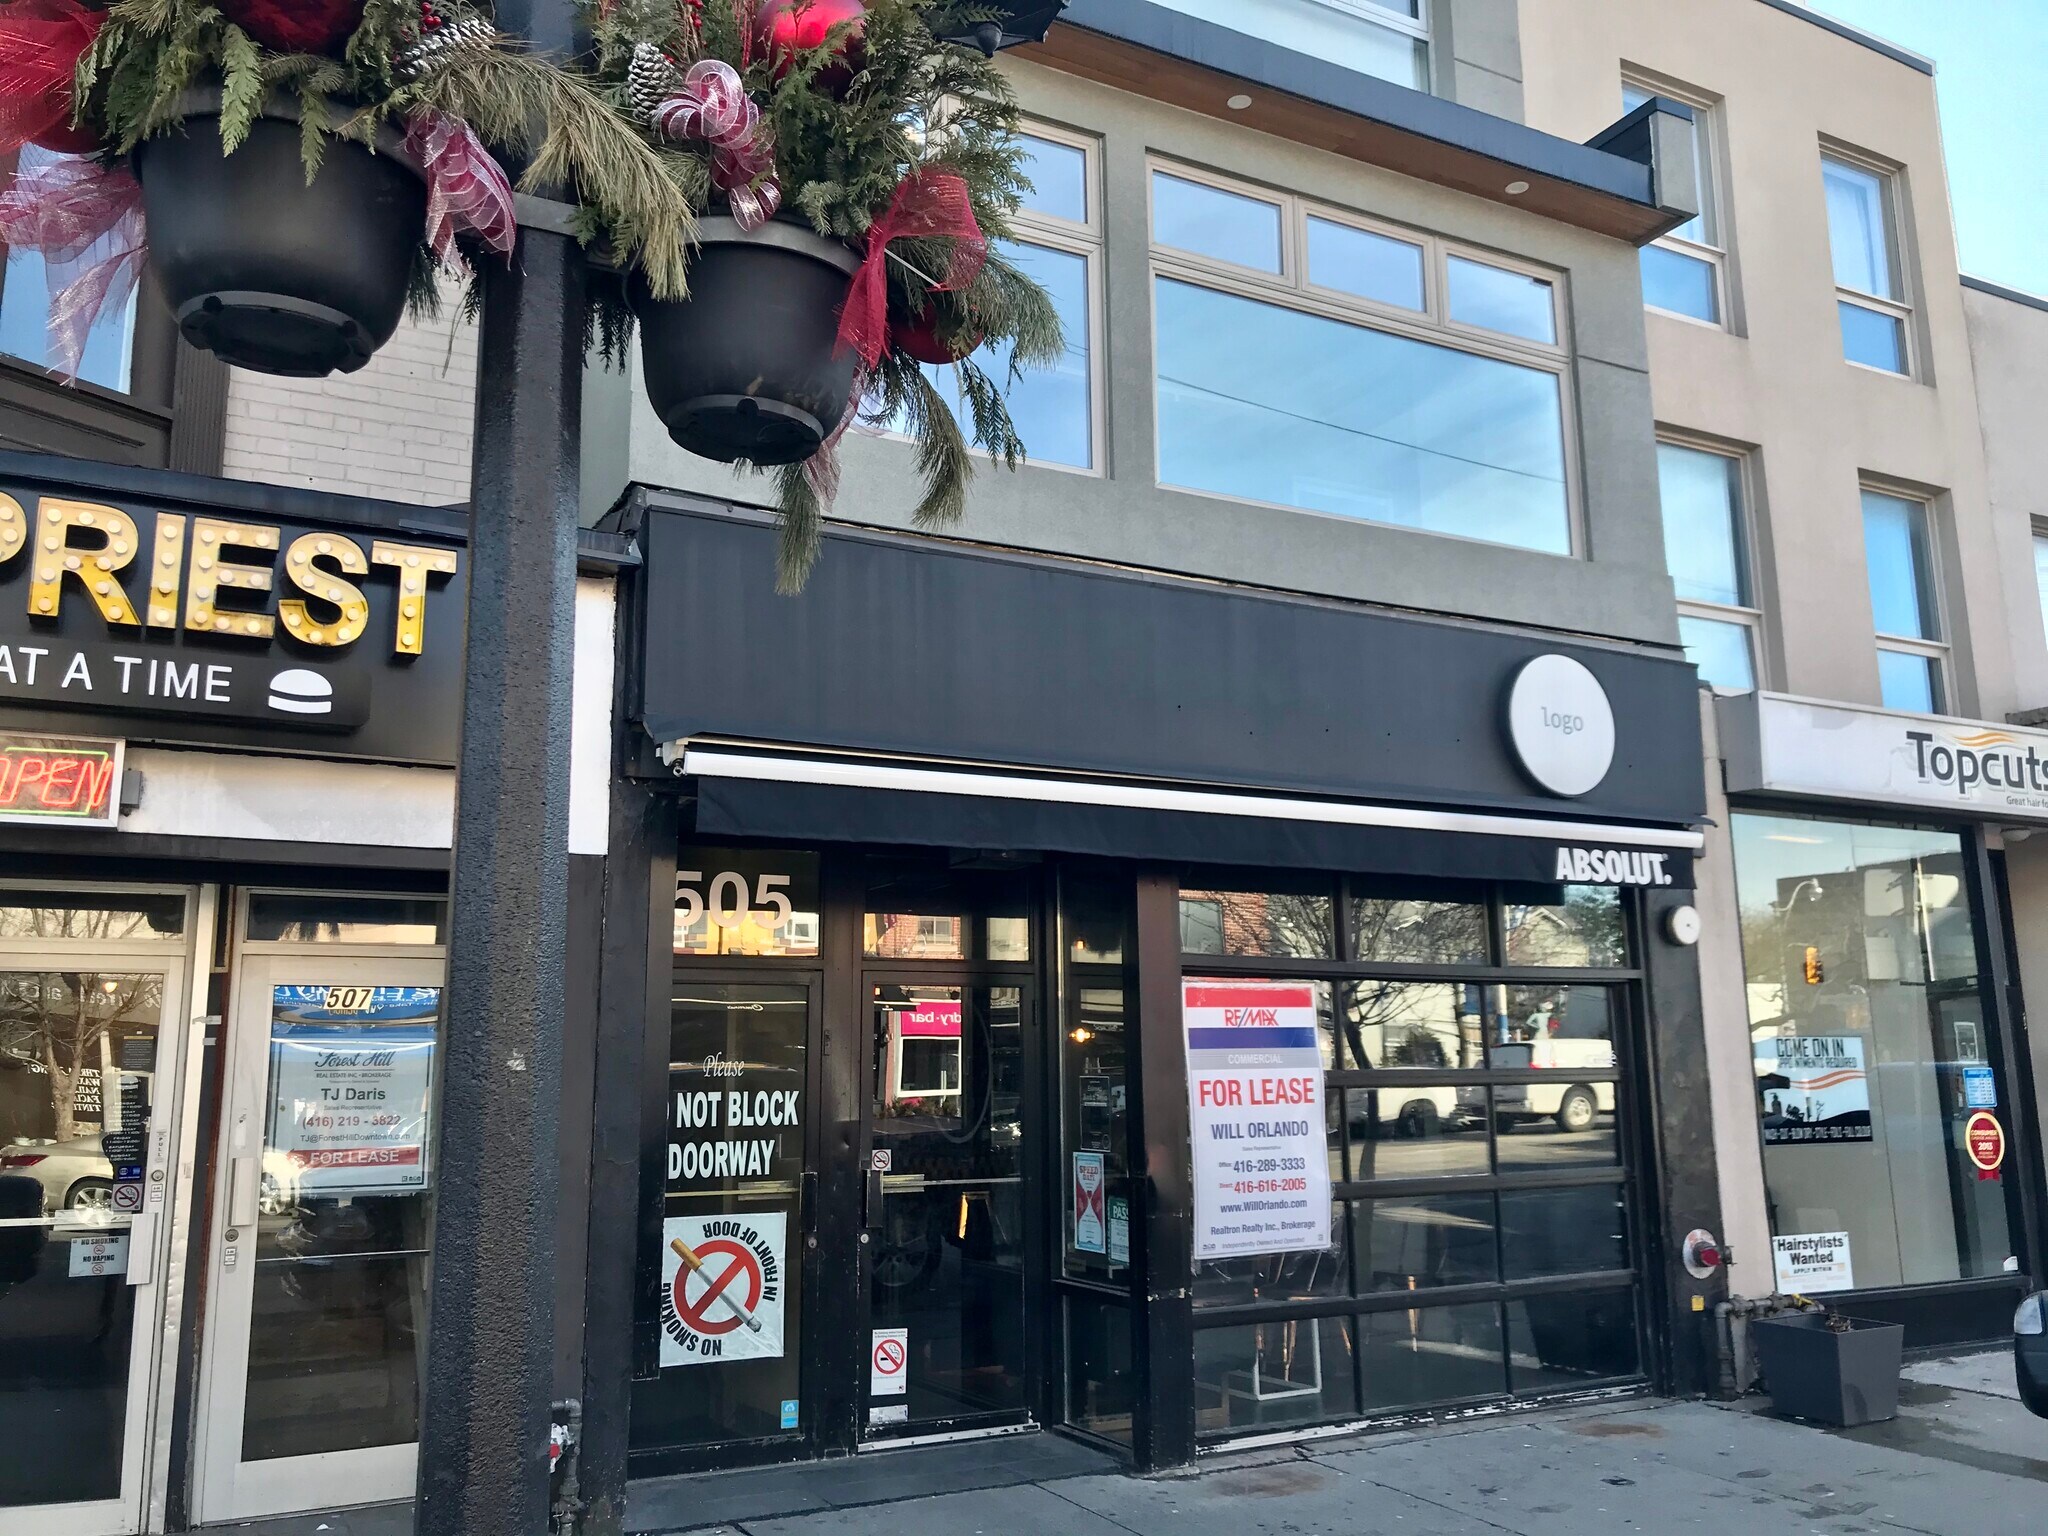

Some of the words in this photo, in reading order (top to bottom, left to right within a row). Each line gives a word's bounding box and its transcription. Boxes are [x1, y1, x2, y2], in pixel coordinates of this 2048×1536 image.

[0, 491, 457, 654] RIEST
[62, 653, 93, 690] A
[114, 656, 233, 702] TIME
[1540, 706, 1584, 735] logo
[2006, 796, 2026, 806] Great
[2027, 796, 2041, 808] hair
[1556, 847, 1673, 885] ABSOLUT.
[674, 871, 792, 929] 505
[326, 988, 372, 1008] 507
[1224, 1008, 1279, 1027] RE/MAX
[1776, 1038, 1809, 1057] COME
[1812, 1038, 1829, 1057] ON
[1833, 1038, 1844, 1057] IN
[315, 1051, 359, 1068] Forest
[362, 1050, 396, 1067] Hill
[703, 1051, 744, 1077] Please
[1228, 1054, 1283, 1065] COMMERCIAL
[321, 1088, 340, 1101] TJ
[346, 1087, 386, 1100] Daris
[1199, 1079, 1243, 1107] FOR
[1250, 1078, 1315, 1105] LEASE
[676, 1091, 722, 1128] NOT
[728, 1090, 799, 1127] BLOCK
[302, 1117, 334, 1129] (416)
[338, 1116, 360, 1127] 219
[371, 1115, 401, 1126] 3822
[1211, 1123, 1245, 1140] WILL
[1248, 1120, 1309, 1138] ORLANDO
[310, 1152, 343, 1164] FOR
[348, 1150, 399, 1163] LEASE
[668, 1140, 775, 1179] DOORWAY
[1233, 1157, 1306, 1173] 416-289-3333
[1079, 1165, 1099, 1175] SPEED
[1234, 1178, 1307, 1194] 416-616-2005
[1220, 1199, 1308, 1213] www.WillOrlando.com
[702, 1221, 741, 1239] DOOR
[739, 1227, 758, 1245] OF
[1211, 1224, 1241, 1236] Realtron
[1242, 1223, 1264, 1234] Realty
[1281, 1219, 1316, 1231] Brokerage
[90, 1237, 120, 1245] SMOKING
[1777, 1235, 1844, 1252] Hairstylists
[82, 1255, 92, 1263] NO
[92, 1254, 115, 1262] VAPING
[753, 1240, 778, 1283] FRONT
[1789, 1250, 1834, 1265] Wanted
[762, 1285, 778, 1302] IN
[700, 1338, 722, 1356] NO
